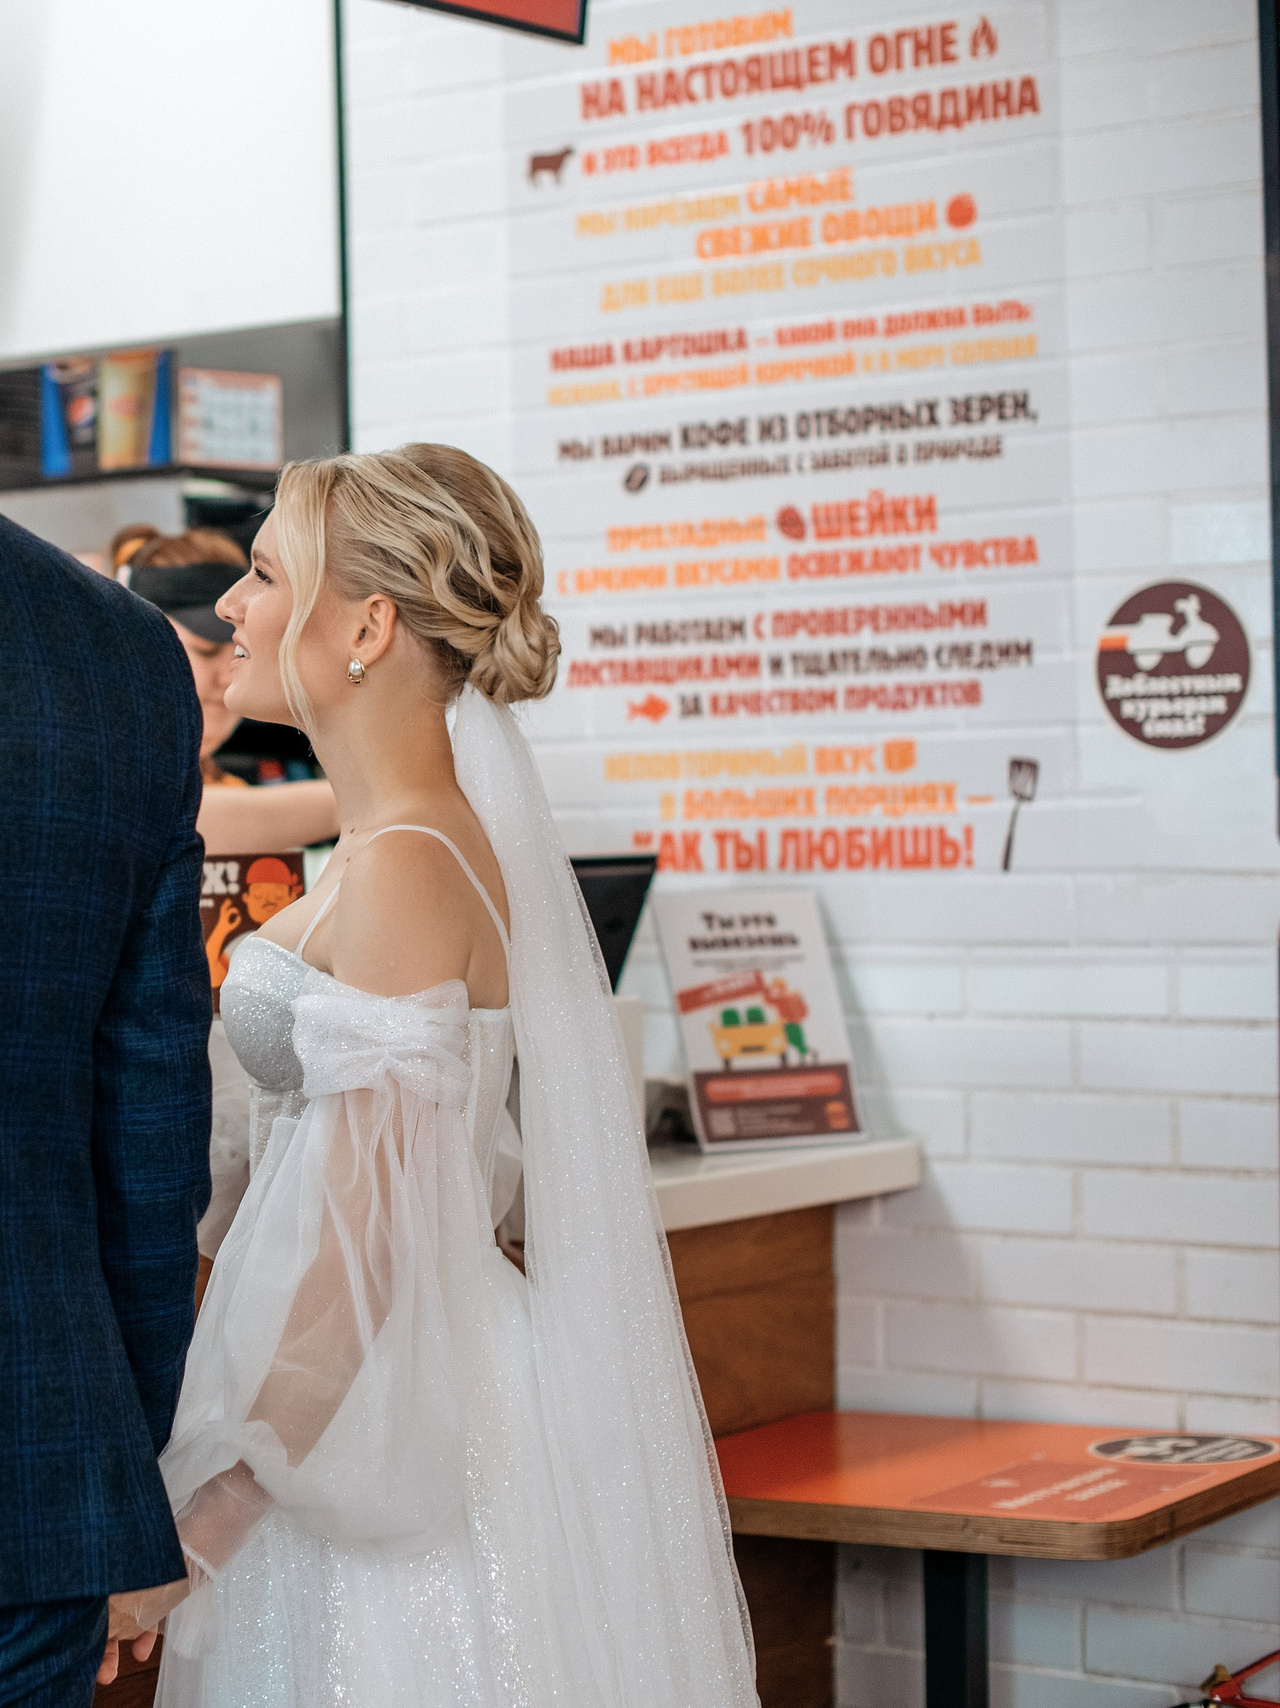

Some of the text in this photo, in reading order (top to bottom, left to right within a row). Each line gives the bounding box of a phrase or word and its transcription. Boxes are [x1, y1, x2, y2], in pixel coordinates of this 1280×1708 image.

[664, 7, 794, 58] ГОТОВИМ
[580, 20, 959, 121] НА НАСТОЯЩЕМ ОГНЕ
[741, 108, 835, 157] 100%
[844, 75, 1041, 140] ГОВЯДИНА
[745, 166, 855, 214] САМЫЕ
[694, 200, 938, 261] СВЕЖИЕ ОВОЩИ
[903, 236, 982, 275] ВКУСА
[621, 326, 749, 365] КАРТОШКА
[556, 437, 596, 463] МЫ
[678, 419, 750, 452] КОФЕ
[757, 414, 789, 444] ИЗ
[794, 399, 940, 440] ОТБОРНЫХ
[809, 488, 939, 542] ШЕЙКИ
[673, 553, 782, 588] ВКУСАМИ
[786, 543, 924, 583] ОСВЕЖАЮТ
[928, 533, 1039, 574] ЧУВСТВА
[589, 622, 630, 651] МЫ
[633, 615, 748, 648] РАБОТАЕМ
[771, 596, 989, 642] ПРОВЕРЕННЫМИ
[790, 642, 927, 679] ТЩАТЕЛЬНО
[933, 637, 1035, 670] СЛЕДИМ
[708, 683, 840, 718] КАЧЕСТВОМ
[843, 676, 983, 715] ПРОДУКТОВ
[814, 742, 878, 776] ВКУС
[682, 784, 819, 822] БОЛЬШИХ
[823, 780, 959, 819] ПОРЦИЯХ
[710, 825, 769, 873] ТЫ
[775, 822, 976, 874] ЛЮБИШЬ!
